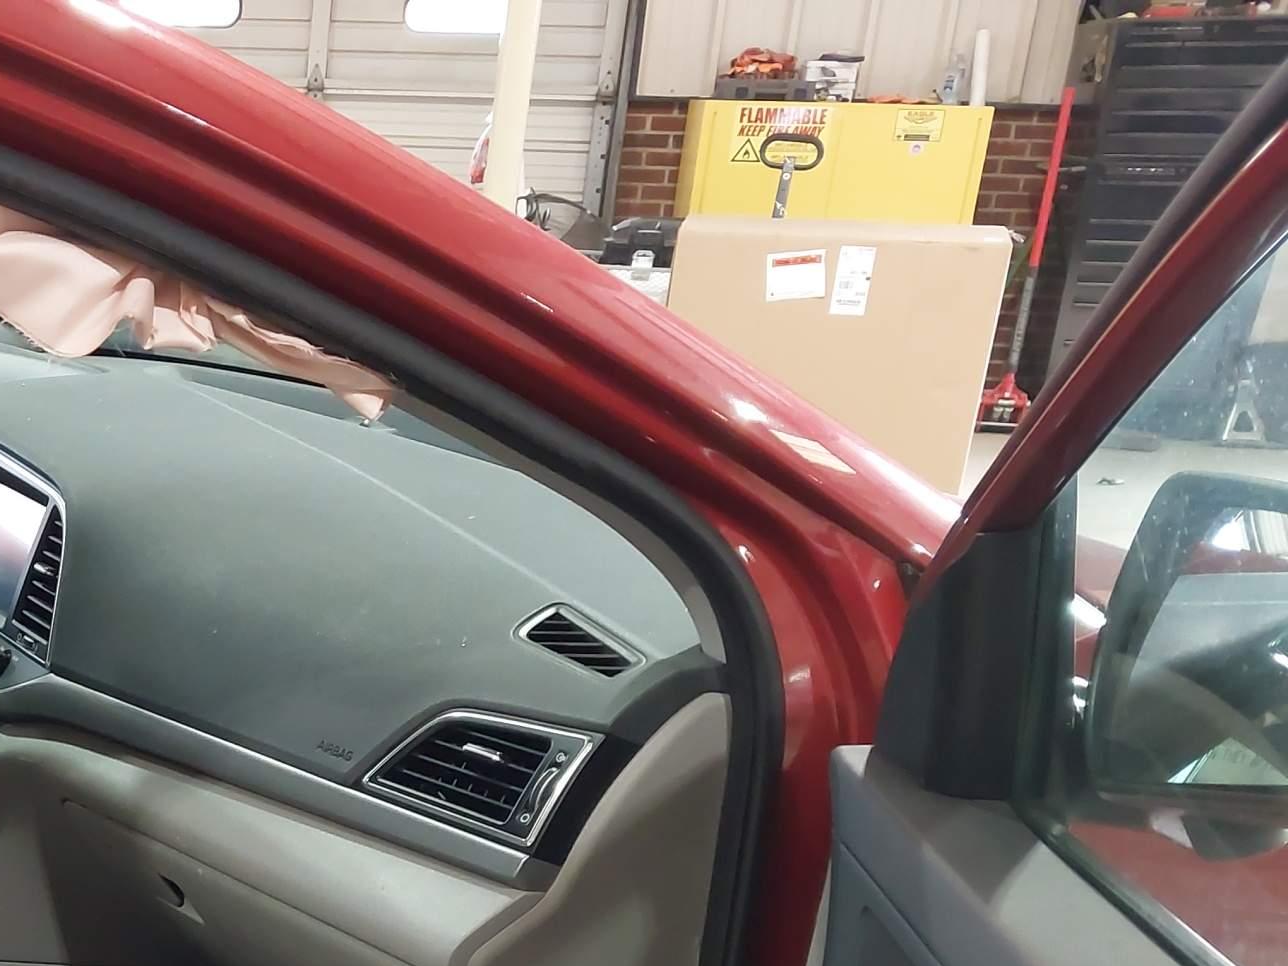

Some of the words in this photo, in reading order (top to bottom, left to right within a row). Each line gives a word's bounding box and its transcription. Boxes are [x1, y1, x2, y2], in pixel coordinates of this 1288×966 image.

[739, 107, 828, 124] FLAMMABLE
[737, 125, 766, 137] KEEP
[792, 126, 825, 137] AWAY
